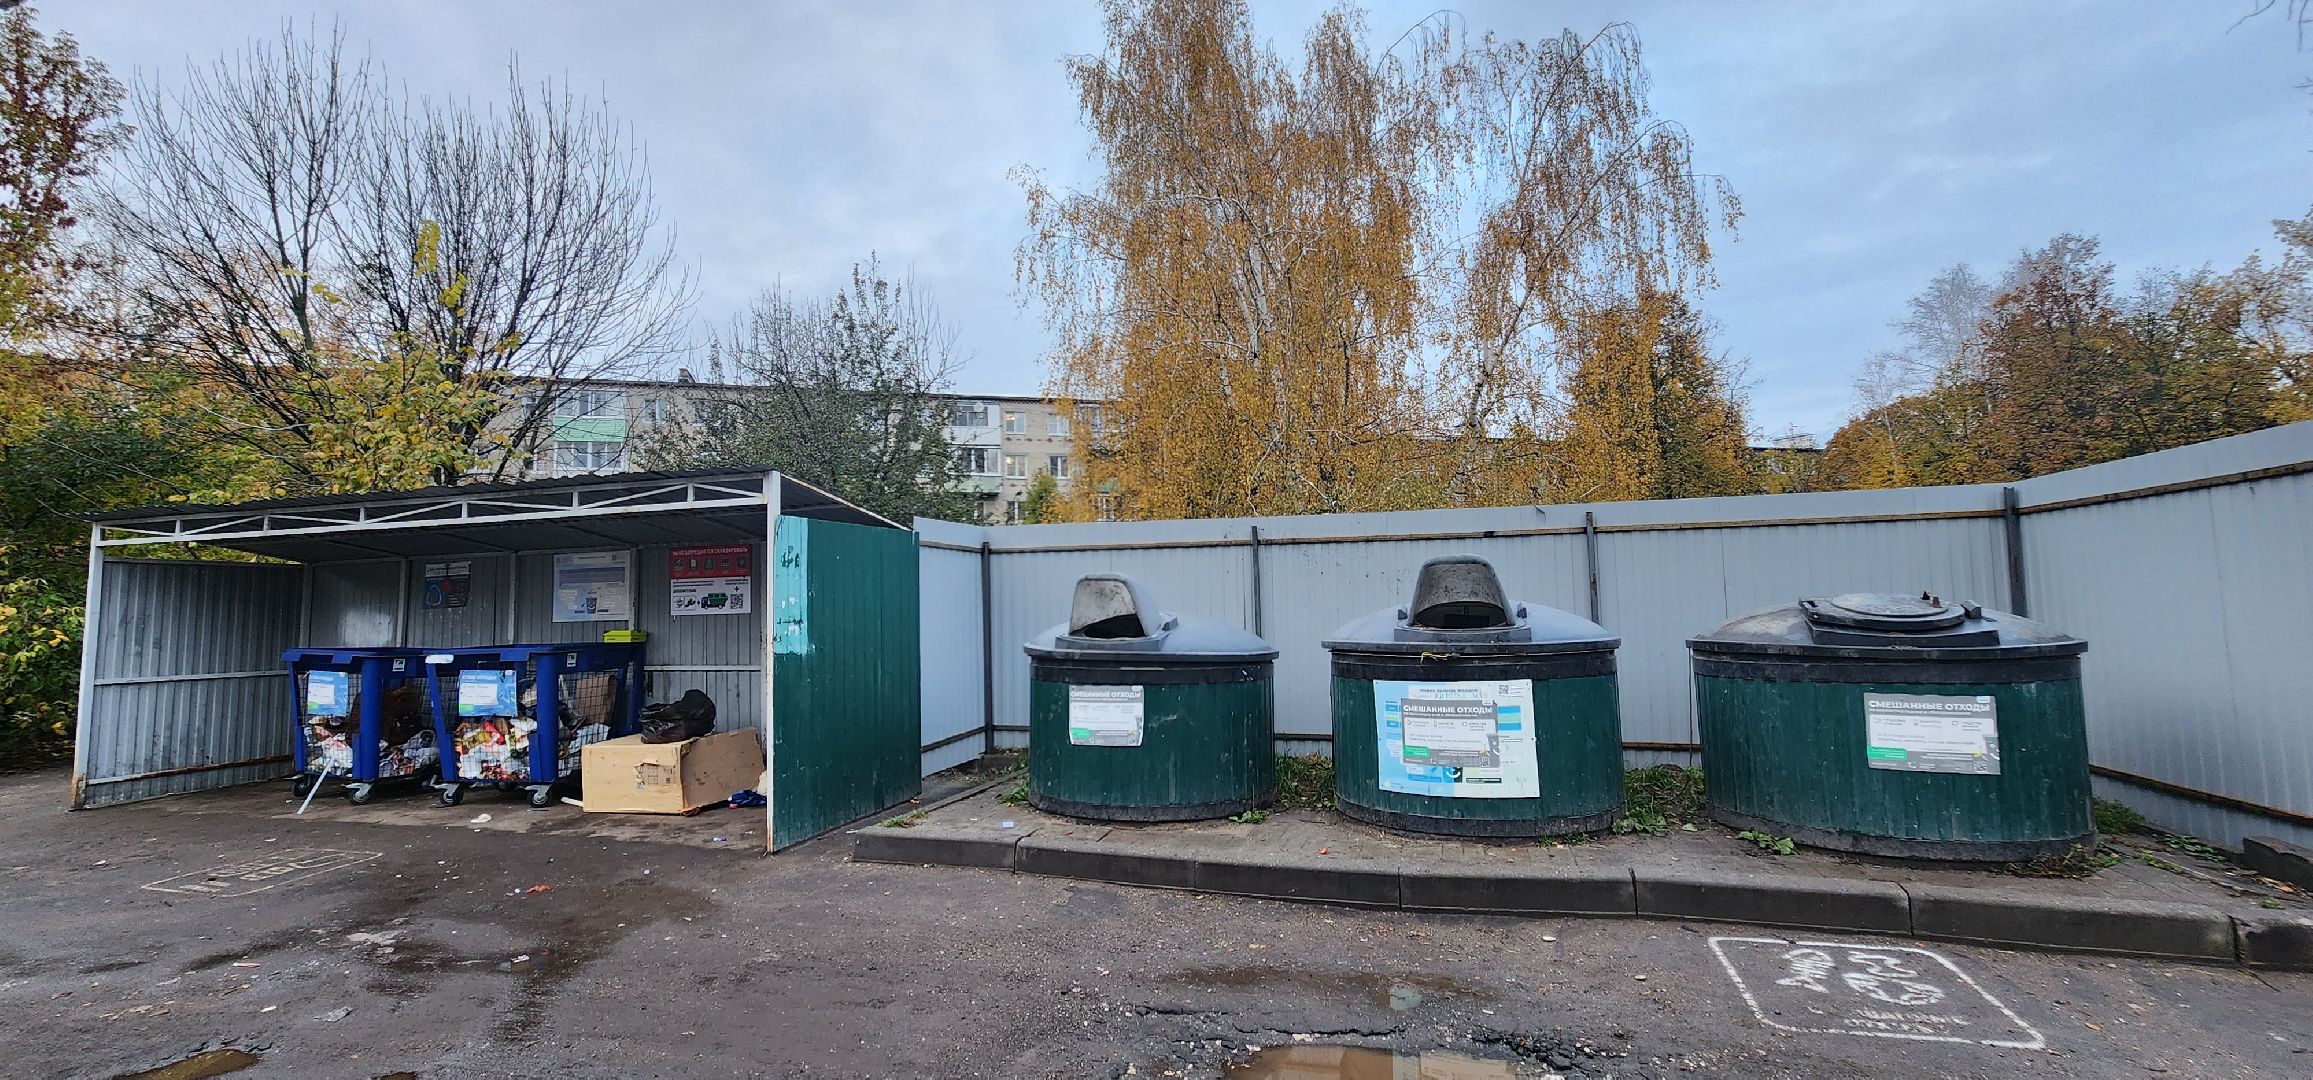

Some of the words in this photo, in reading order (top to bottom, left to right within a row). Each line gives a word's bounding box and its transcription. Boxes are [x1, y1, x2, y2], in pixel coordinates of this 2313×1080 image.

[1403, 705, 1456, 713] СМЕШАННЫЕ
[1457, 706, 1492, 715] ОТХОДЫ
[1868, 700, 1943, 710] СМЕШАННЫЕ
[1944, 703, 1990, 712] ОТХОДЫ
